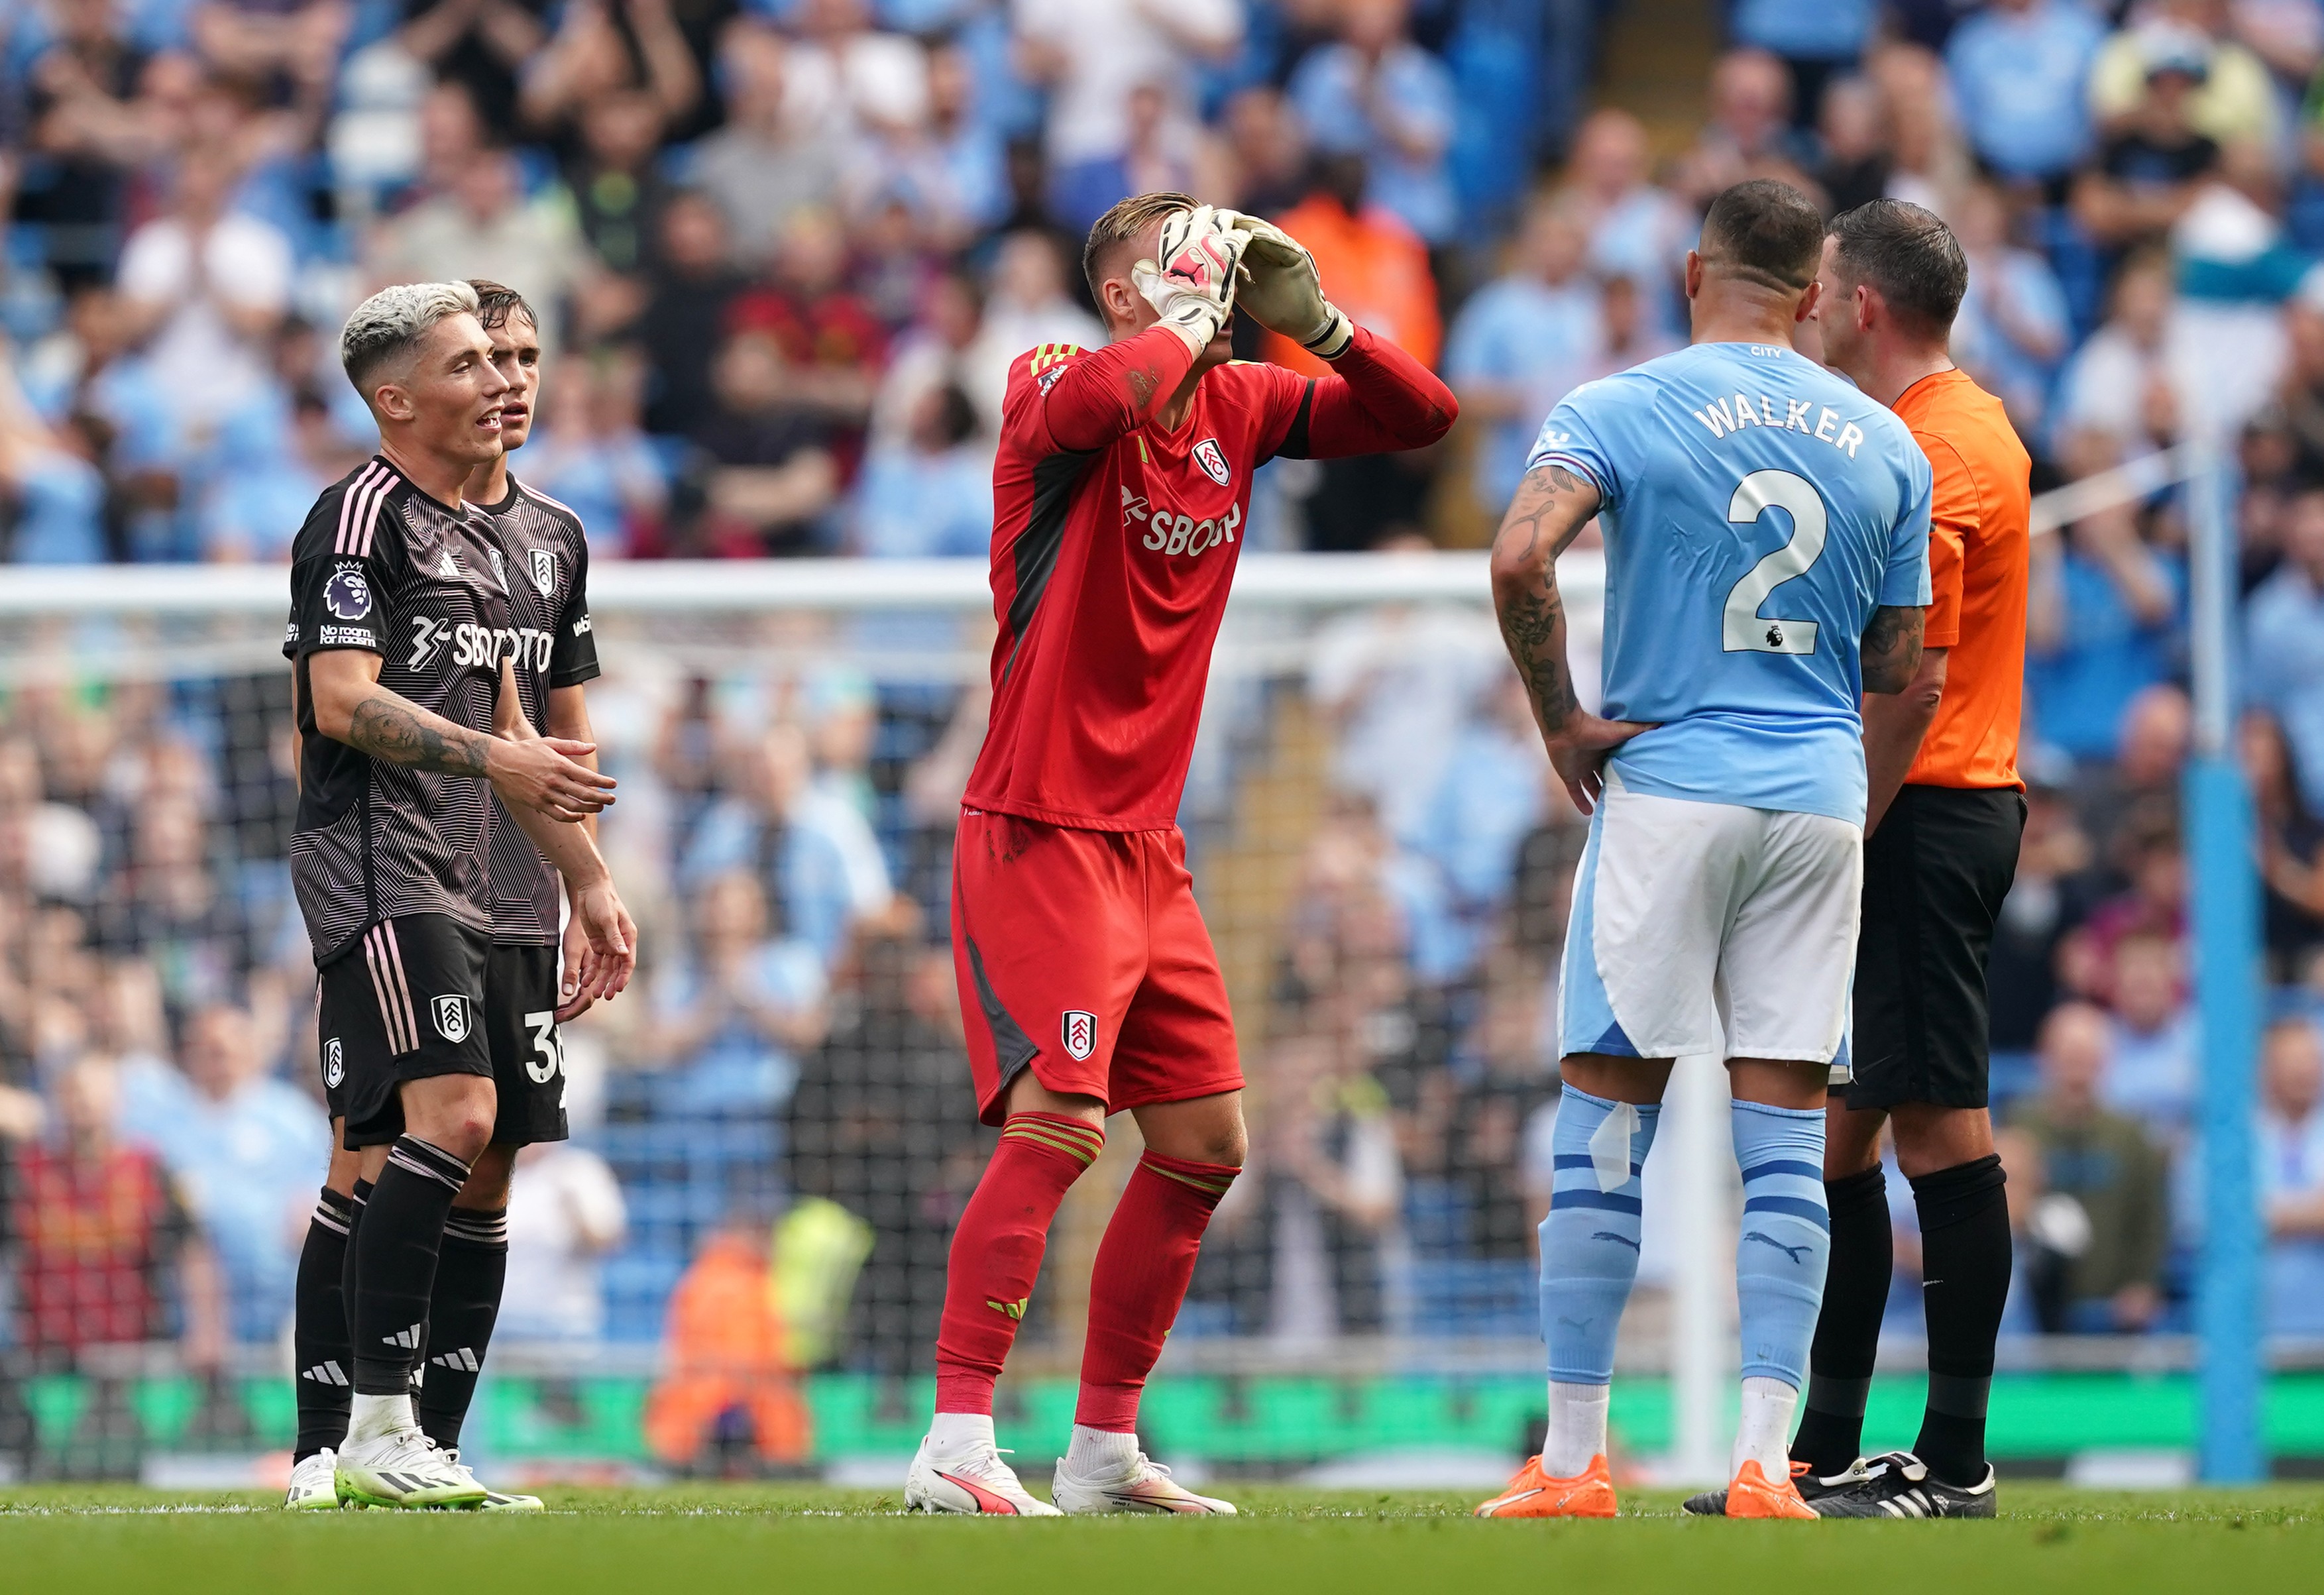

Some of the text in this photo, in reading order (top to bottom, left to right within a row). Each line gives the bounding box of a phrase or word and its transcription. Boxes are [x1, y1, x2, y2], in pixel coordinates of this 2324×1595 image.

[1750, 345, 1782, 358] CITY
[1692, 394, 1864, 461] WALKER
[1722, 468, 1829, 655] 2
[320, 624, 371, 638] No room
[319, 634, 376, 647] for racism
